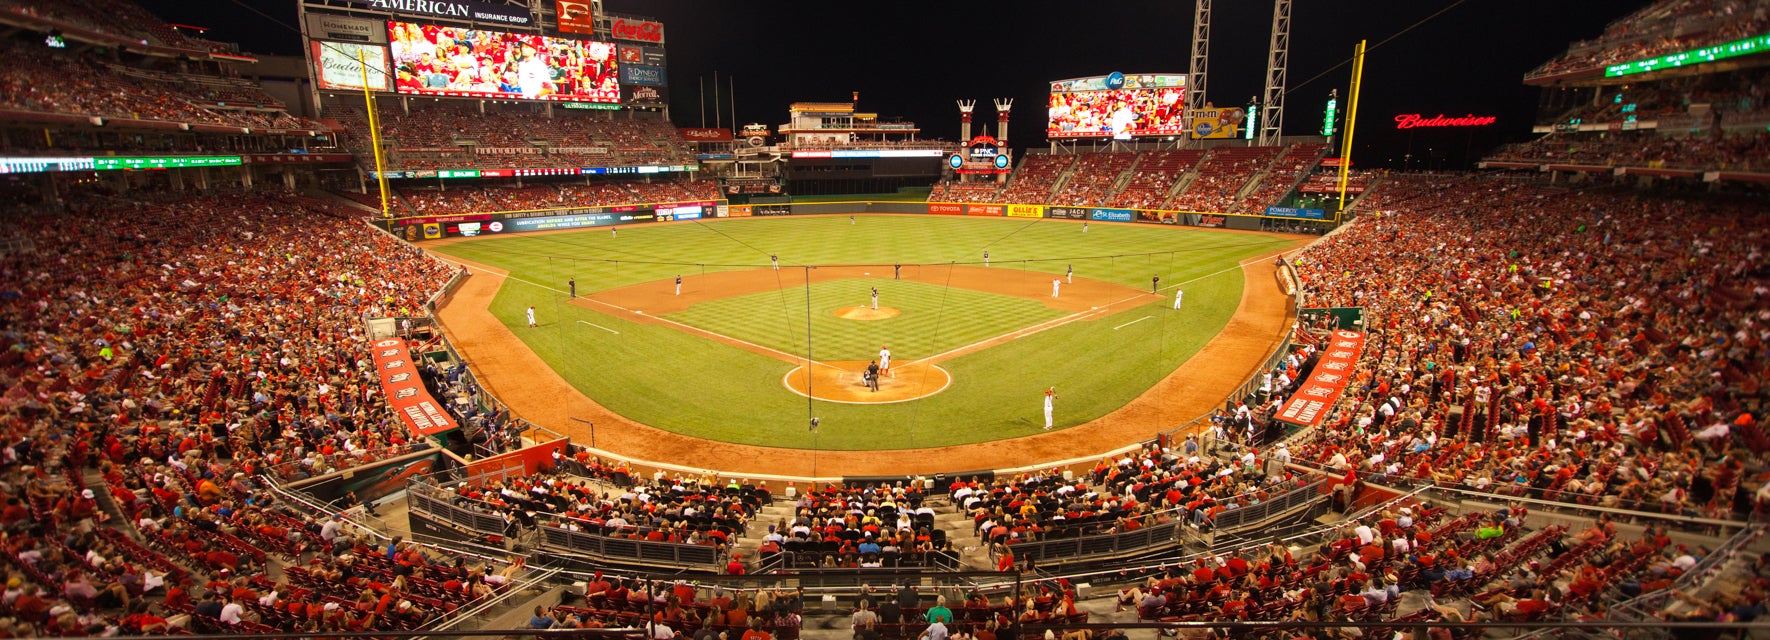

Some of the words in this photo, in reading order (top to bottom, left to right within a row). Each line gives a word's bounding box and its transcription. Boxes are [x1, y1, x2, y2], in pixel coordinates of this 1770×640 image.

[372, 0, 470, 17] AMERICAN
[475, 12, 508, 22] INSURANCE
[509, 15, 528, 24] GROUP
[323, 21, 369, 31] HOMEMADE
[612, 19, 662, 42] Coca-Cola
[634, 68, 659, 78] DYNEGY
[1395, 113, 1496, 129] Budweiser
